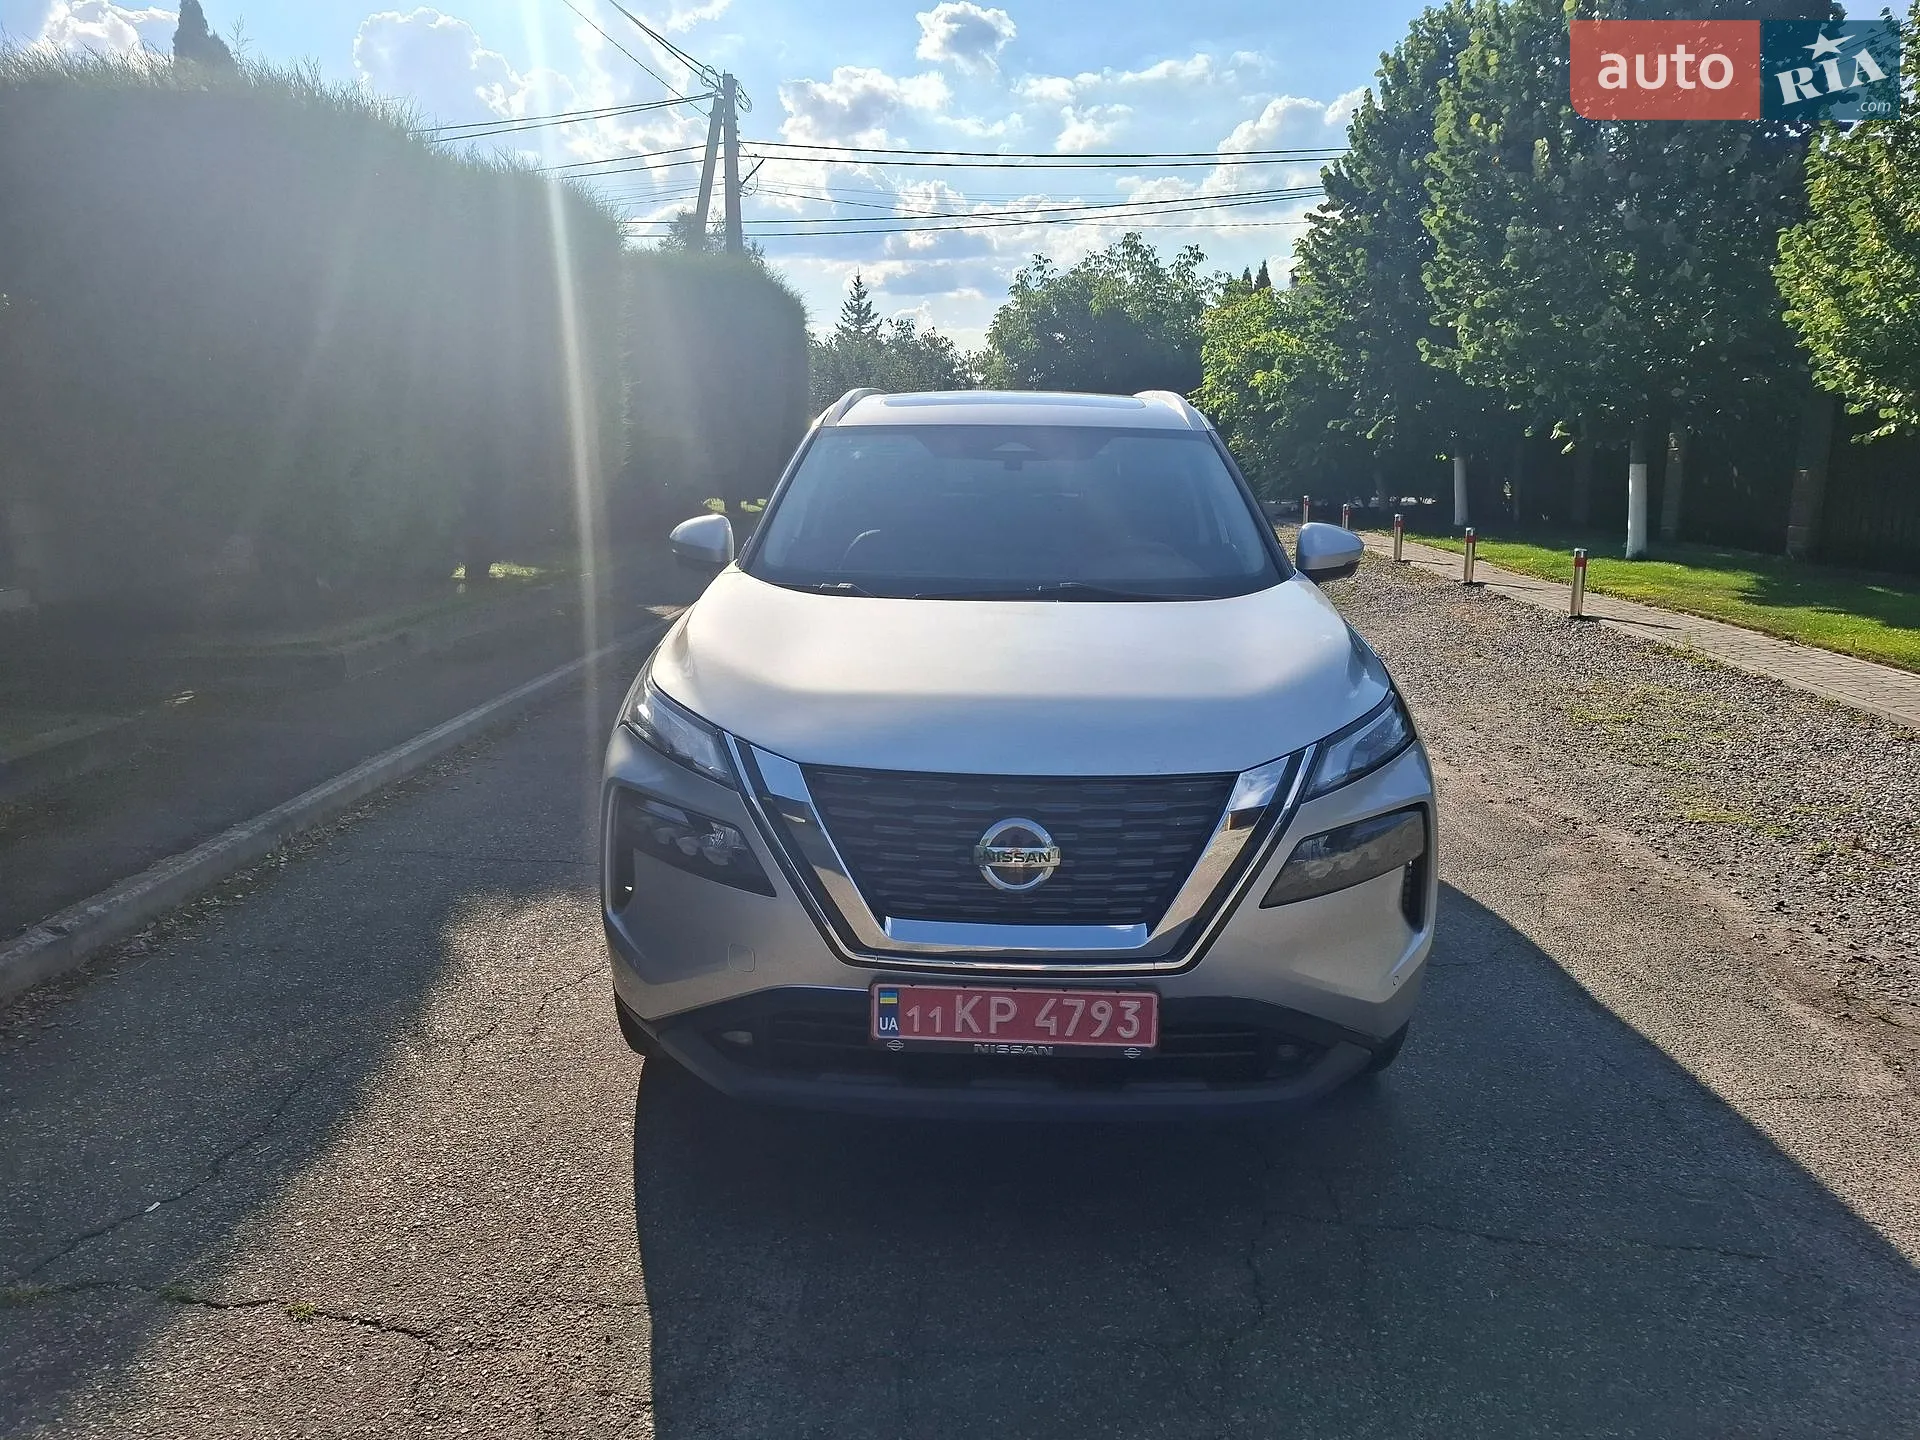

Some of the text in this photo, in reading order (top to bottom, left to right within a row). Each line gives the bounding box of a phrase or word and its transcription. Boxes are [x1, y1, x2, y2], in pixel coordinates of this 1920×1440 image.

[983, 850, 1051, 863] NISSAN
[879, 1016, 899, 1031] UA
[1034, 997, 1142, 1039] 4793
[973, 1043, 1054, 1056] NISSAN
